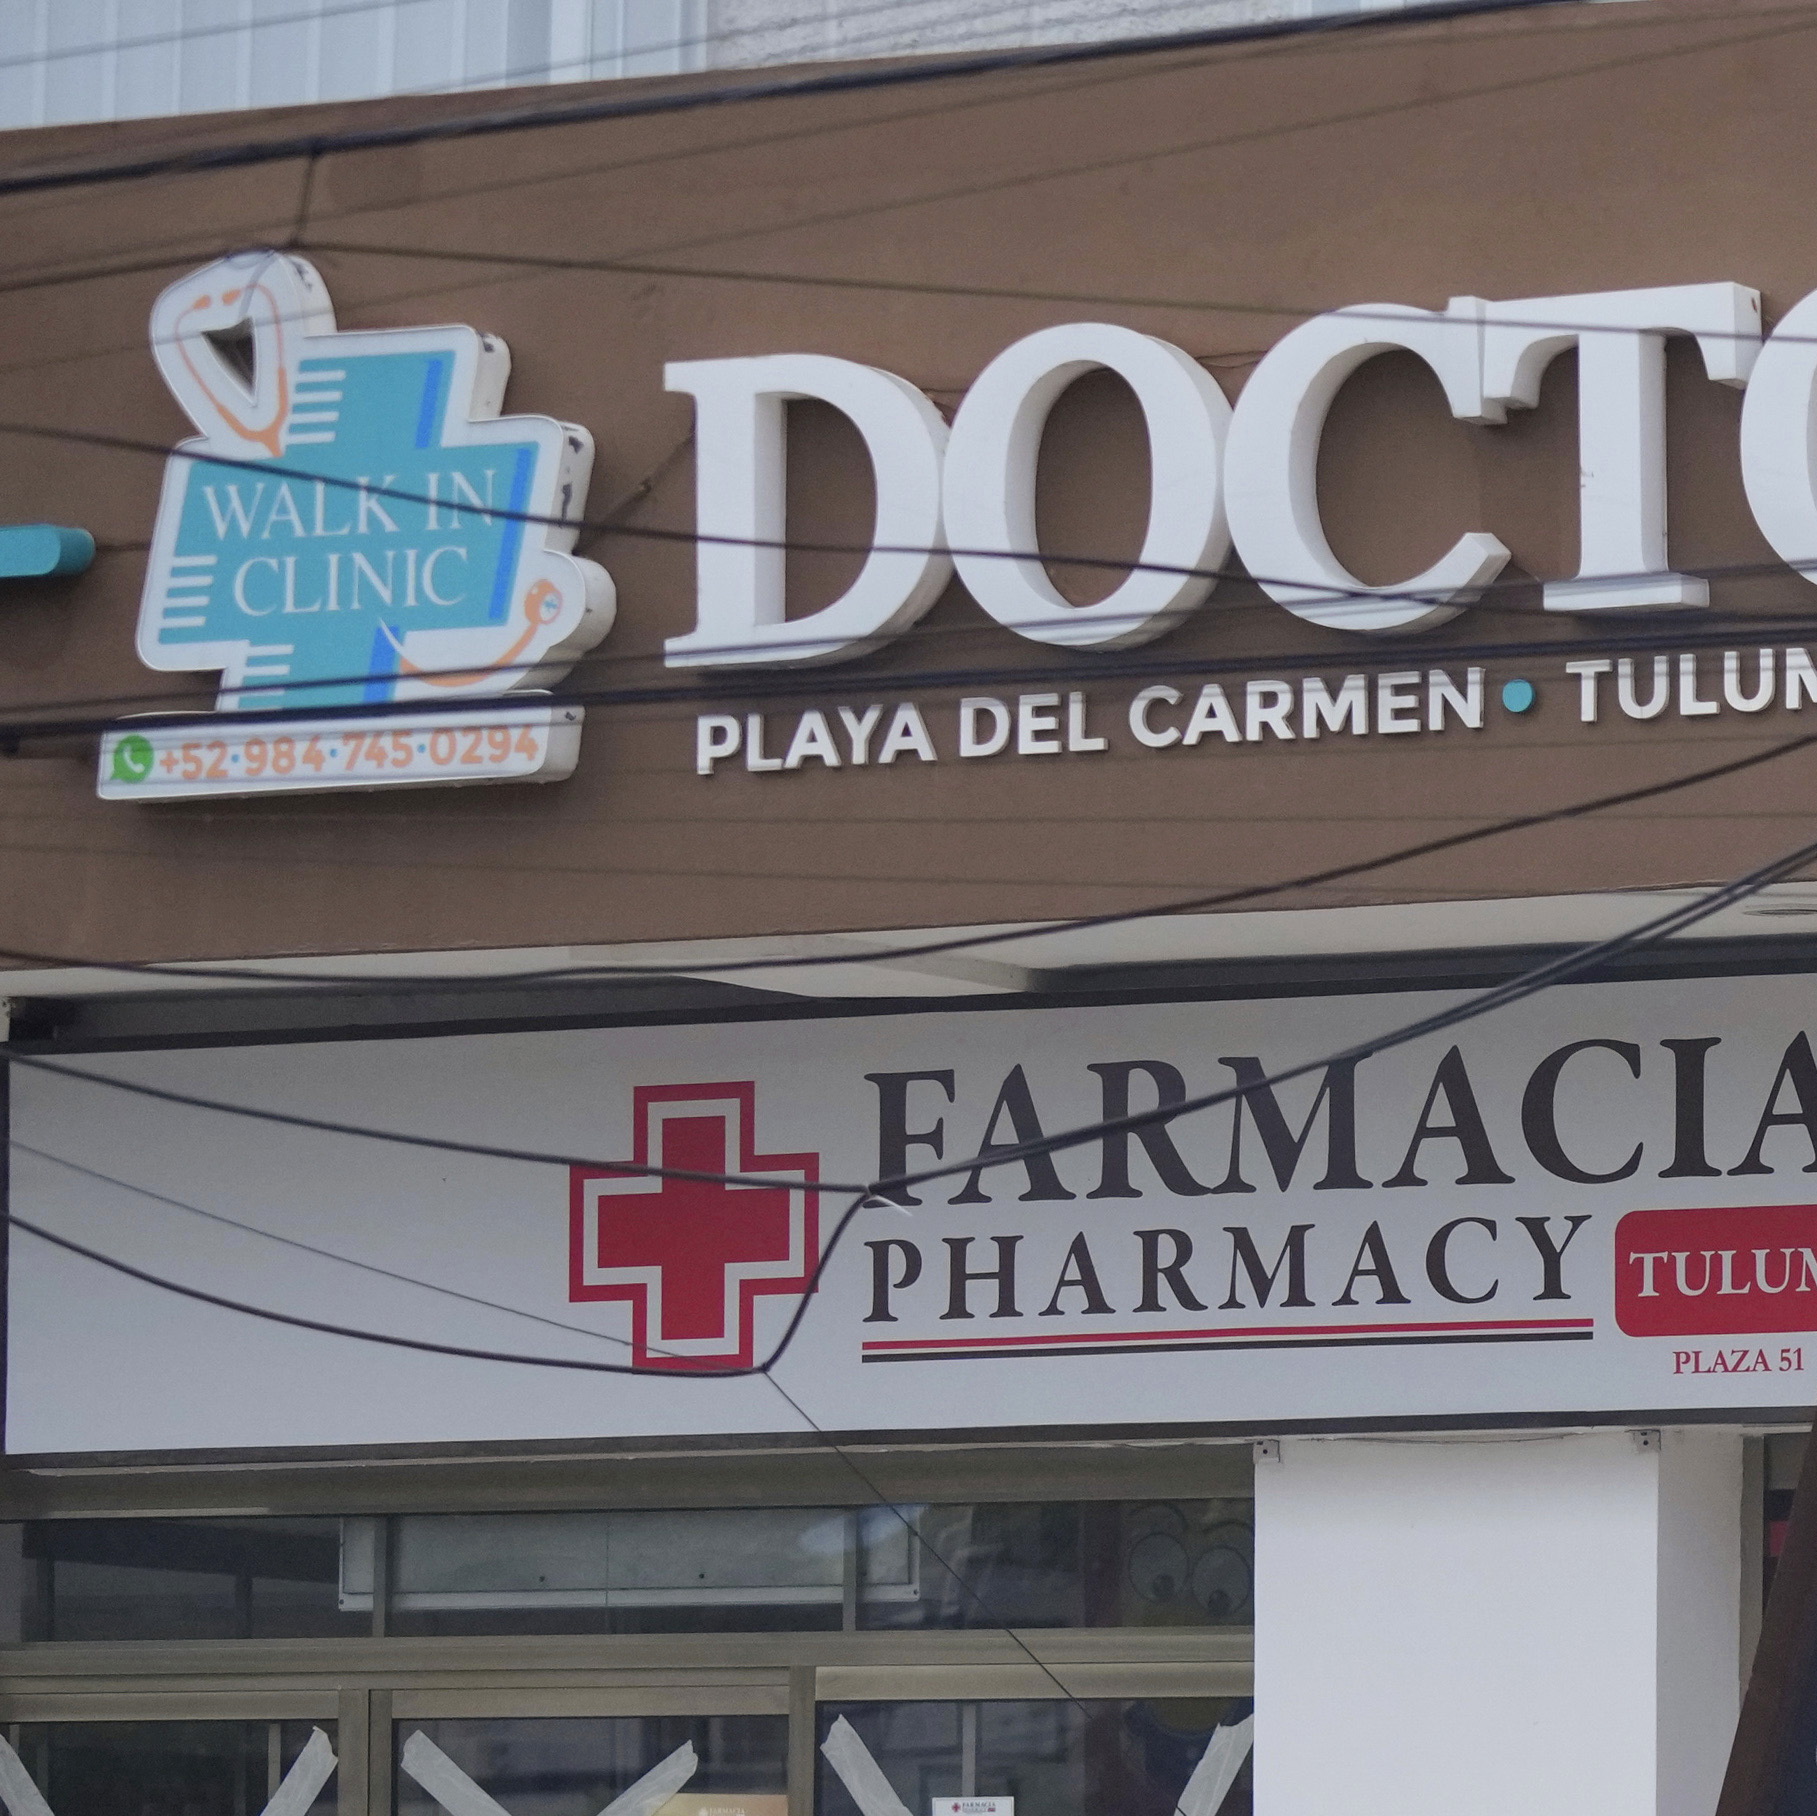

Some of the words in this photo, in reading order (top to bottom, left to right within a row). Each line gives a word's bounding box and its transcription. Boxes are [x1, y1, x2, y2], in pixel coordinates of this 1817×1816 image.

[203, 474, 400, 540] WALK
[425, 468, 496, 532] IN
[233, 546, 469, 617] CLINIC
[696, 703, 937, 775] PLAYA
[958, 692, 1108, 760] DEL
[1128, 666, 1486, 749] CARMEN
[863, 1215, 1592, 1322] PHARMACY
[1673, 1349, 1772, 1375] PLAZA
[1779, 1347, 1804, 1372] 51
